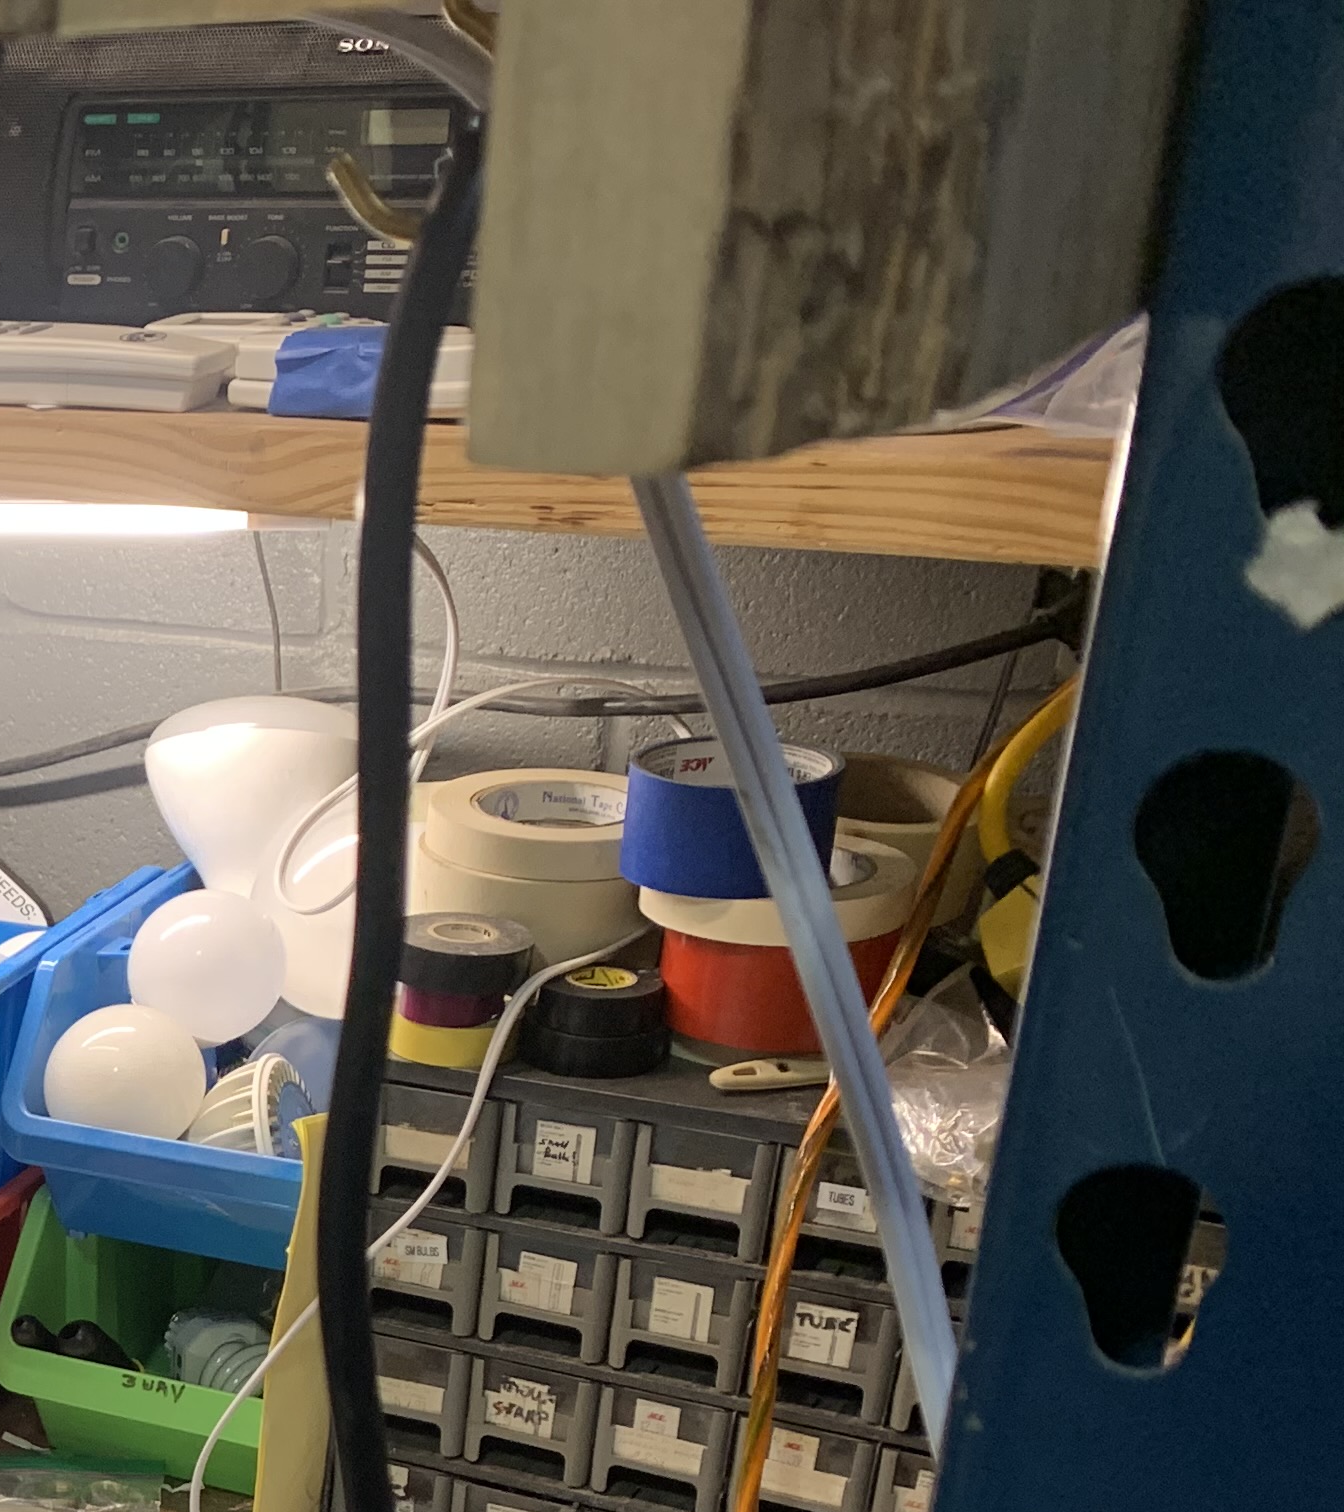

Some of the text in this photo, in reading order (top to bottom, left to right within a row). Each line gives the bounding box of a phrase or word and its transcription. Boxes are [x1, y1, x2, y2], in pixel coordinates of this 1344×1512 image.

[337, 38, 391, 52] SON
[543, 790, 587, 808] National
[591, 794, 613, 811] Tape
[828, 1190, 856, 1207] TUBES
[416, 1246, 440, 1258] BULBS
[121, 1373, 137, 1389] 3
